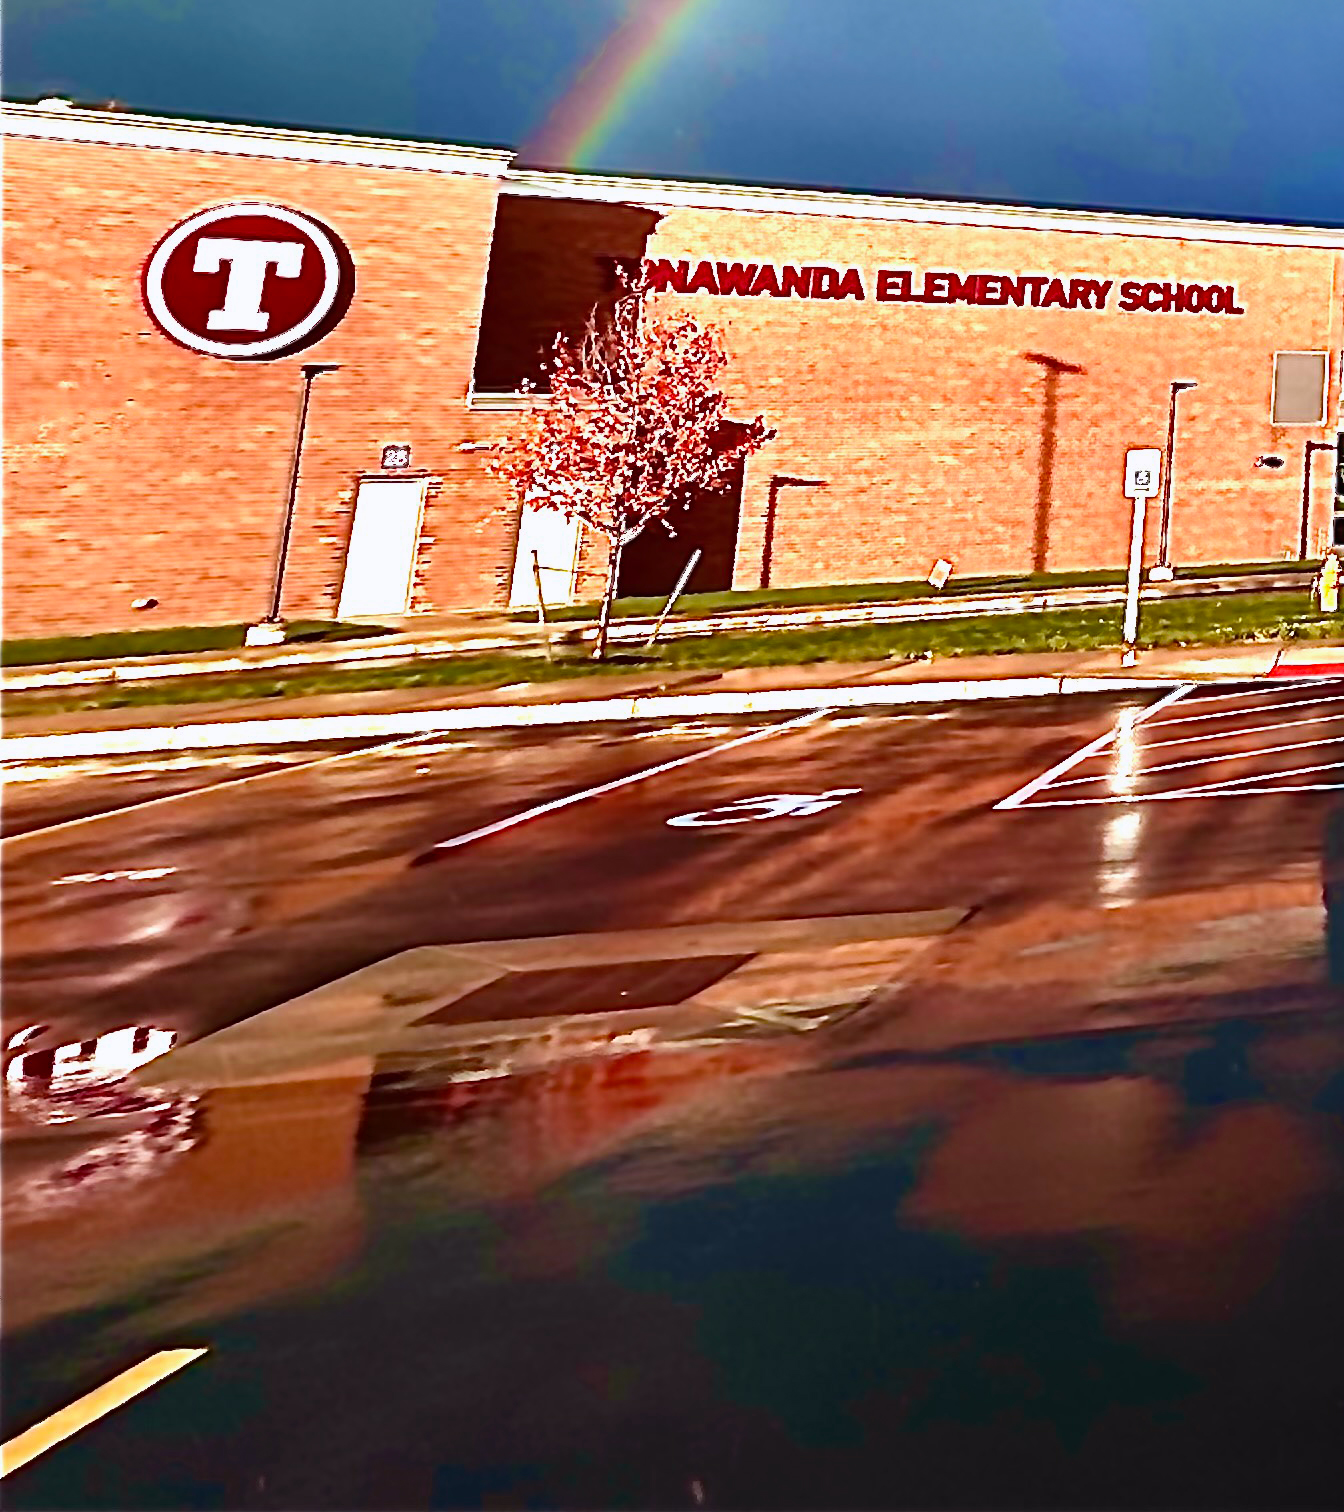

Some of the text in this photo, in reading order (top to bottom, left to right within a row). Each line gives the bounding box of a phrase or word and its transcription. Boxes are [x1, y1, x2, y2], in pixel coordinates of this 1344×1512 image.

[193, 237, 305, 332] T
[876, 269, 1113, 309] ELEMENTARY
[1118, 281, 1244, 315] SCHOOL
